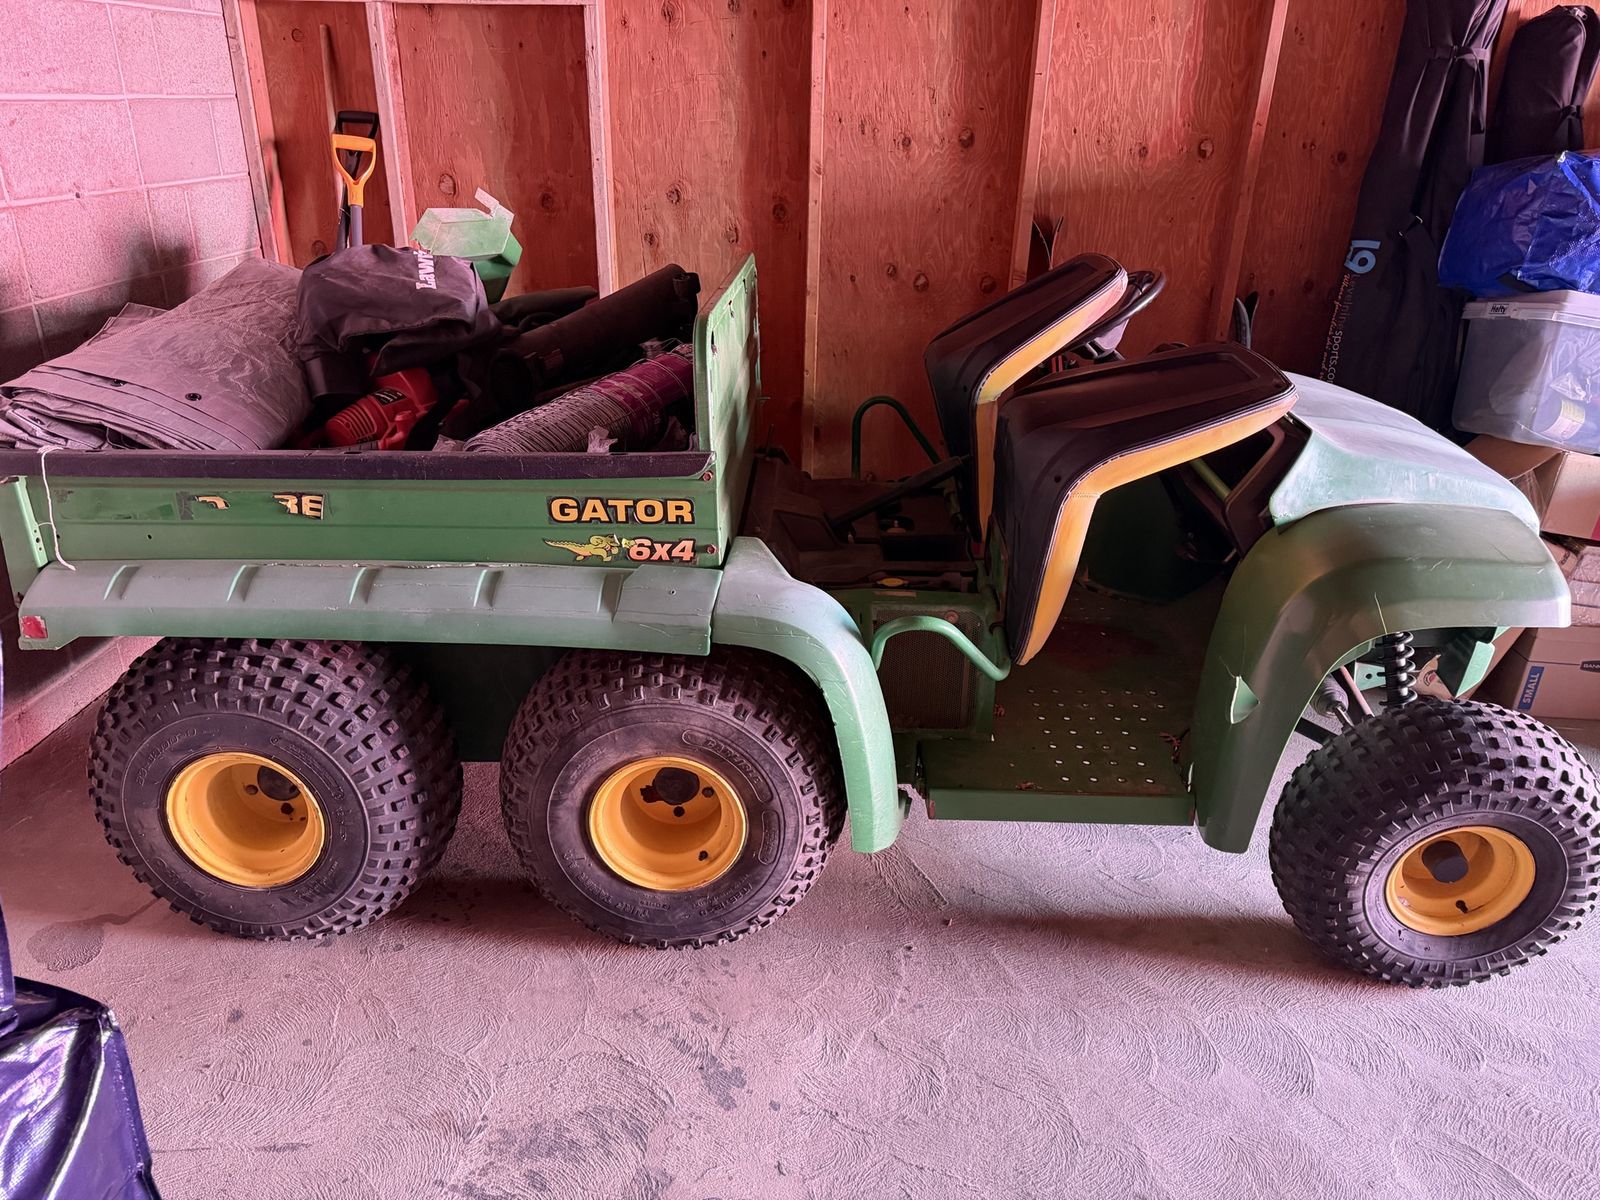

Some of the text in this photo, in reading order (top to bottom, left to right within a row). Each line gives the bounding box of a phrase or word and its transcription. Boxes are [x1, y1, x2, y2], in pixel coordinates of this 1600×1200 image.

[1490, 304, 1507, 314] Hefty
[548, 495, 694, 524] GATOR
[628, 537, 695, 562] 6x4
[1522, 672, 1540, 704] SMALL
